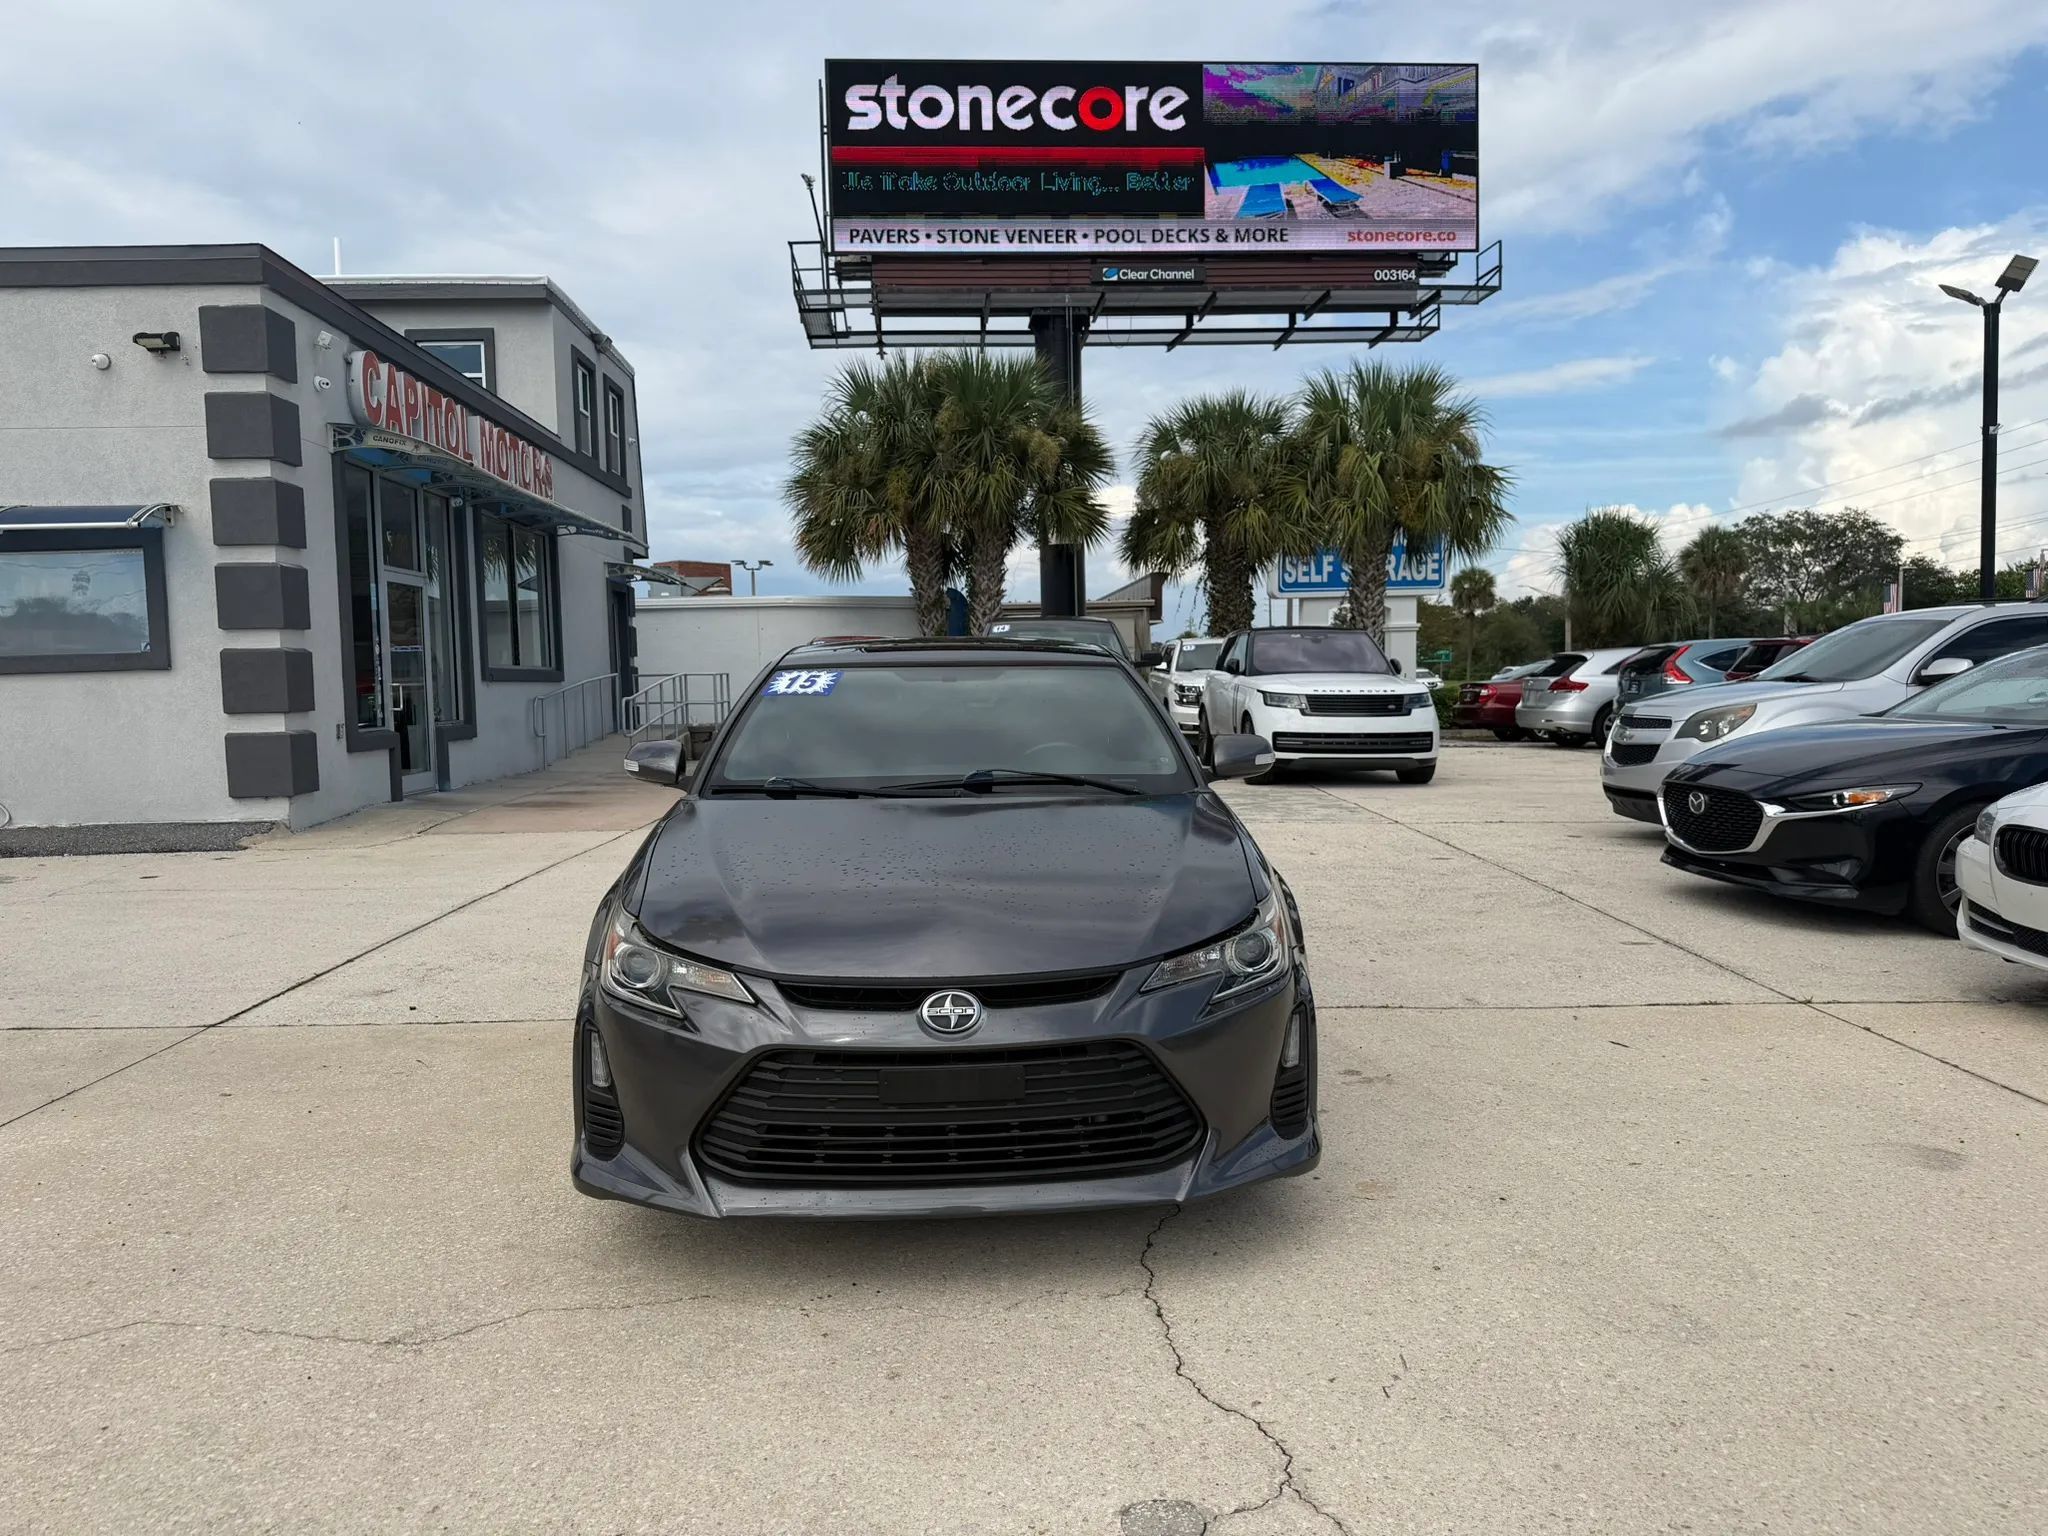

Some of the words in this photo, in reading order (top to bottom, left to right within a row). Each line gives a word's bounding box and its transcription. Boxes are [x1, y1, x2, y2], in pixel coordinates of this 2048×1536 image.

[845, 74, 1190, 131] stonecore
[942, 171, 1031, 191] Outdoor
[1126, 172, 1195, 192] Better
[850, 228, 920, 244] PAVERS
[936, 228, 1000, 244] STONE
[1004, 228, 1077, 244] VENEER
[1094, 228, 1147, 244] POOL
[1152, 228, 1210, 244] DECKS
[1215, 228, 1229, 243] &
[1235, 228, 1289, 243] MORE
[1347, 229, 1457, 243] stonecore.co
[1119, 268, 1149, 280] Clear
[1149, 268, 1195, 280] Channel
[1373, 269, 1417, 281] 003164
[357, 350, 475, 464] CAPITOL
[479, 417, 555, 501] MOTORS
[1283, 554, 1334, 584] SELF
[784, 674, 822, 690] 15
